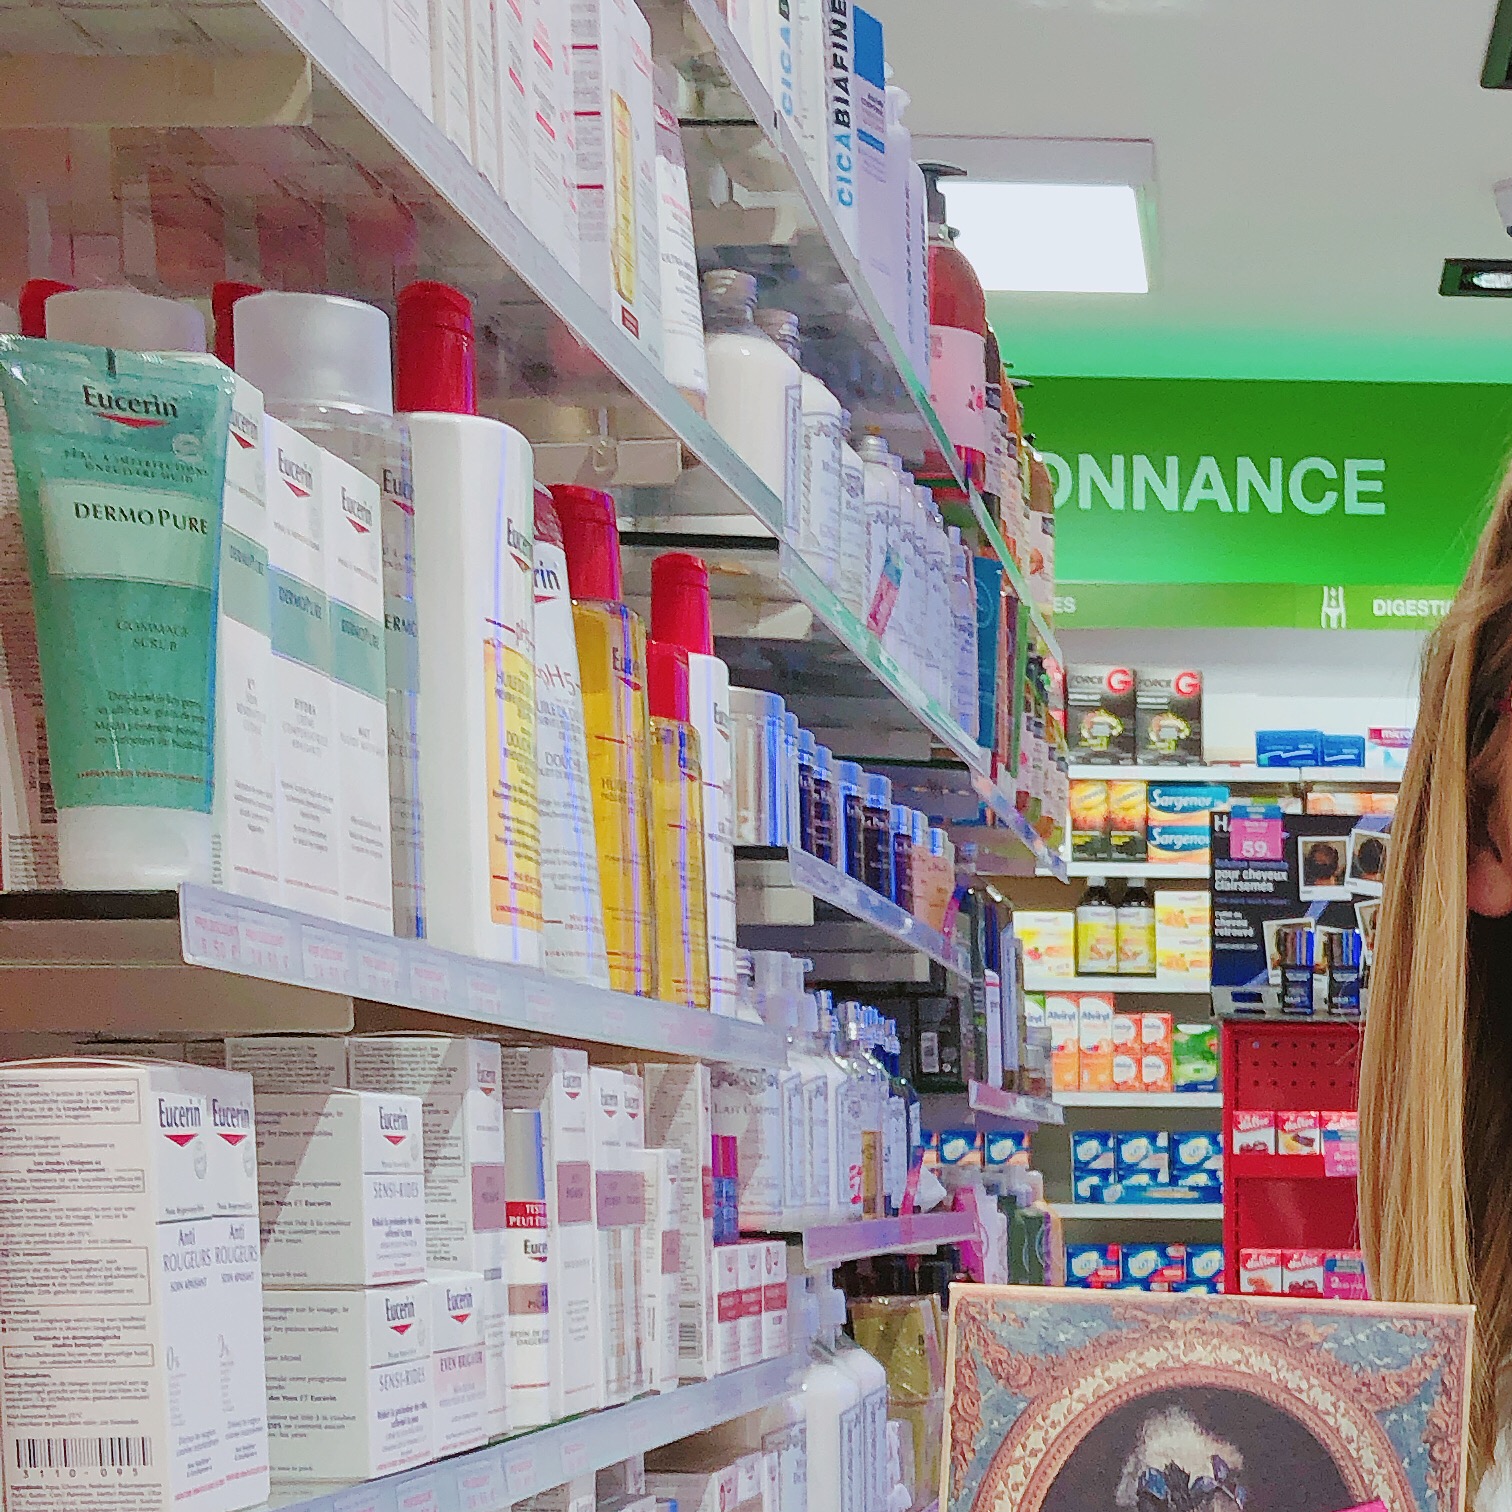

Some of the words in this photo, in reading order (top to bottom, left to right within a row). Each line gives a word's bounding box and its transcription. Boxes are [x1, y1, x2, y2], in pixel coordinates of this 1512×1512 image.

[82, 384, 179, 418] Eucerin
[278, 447, 314, 491] Eucerin
[74, 501, 209, 535] DERMOPURE
[341, 486, 373, 527] Eucerin
[1051, 596, 1077, 614] ES
[158, 1097, 202, 1128] Eucerin
[212, 1098, 250, 1129] Eucerin
[378, 1106, 409, 1132] Eucerin
[523, 1239, 548, 1255] Euce
[385, 1295, 416, 1322] Eucerin
[446, 1286, 474, 1312] Eucerin
